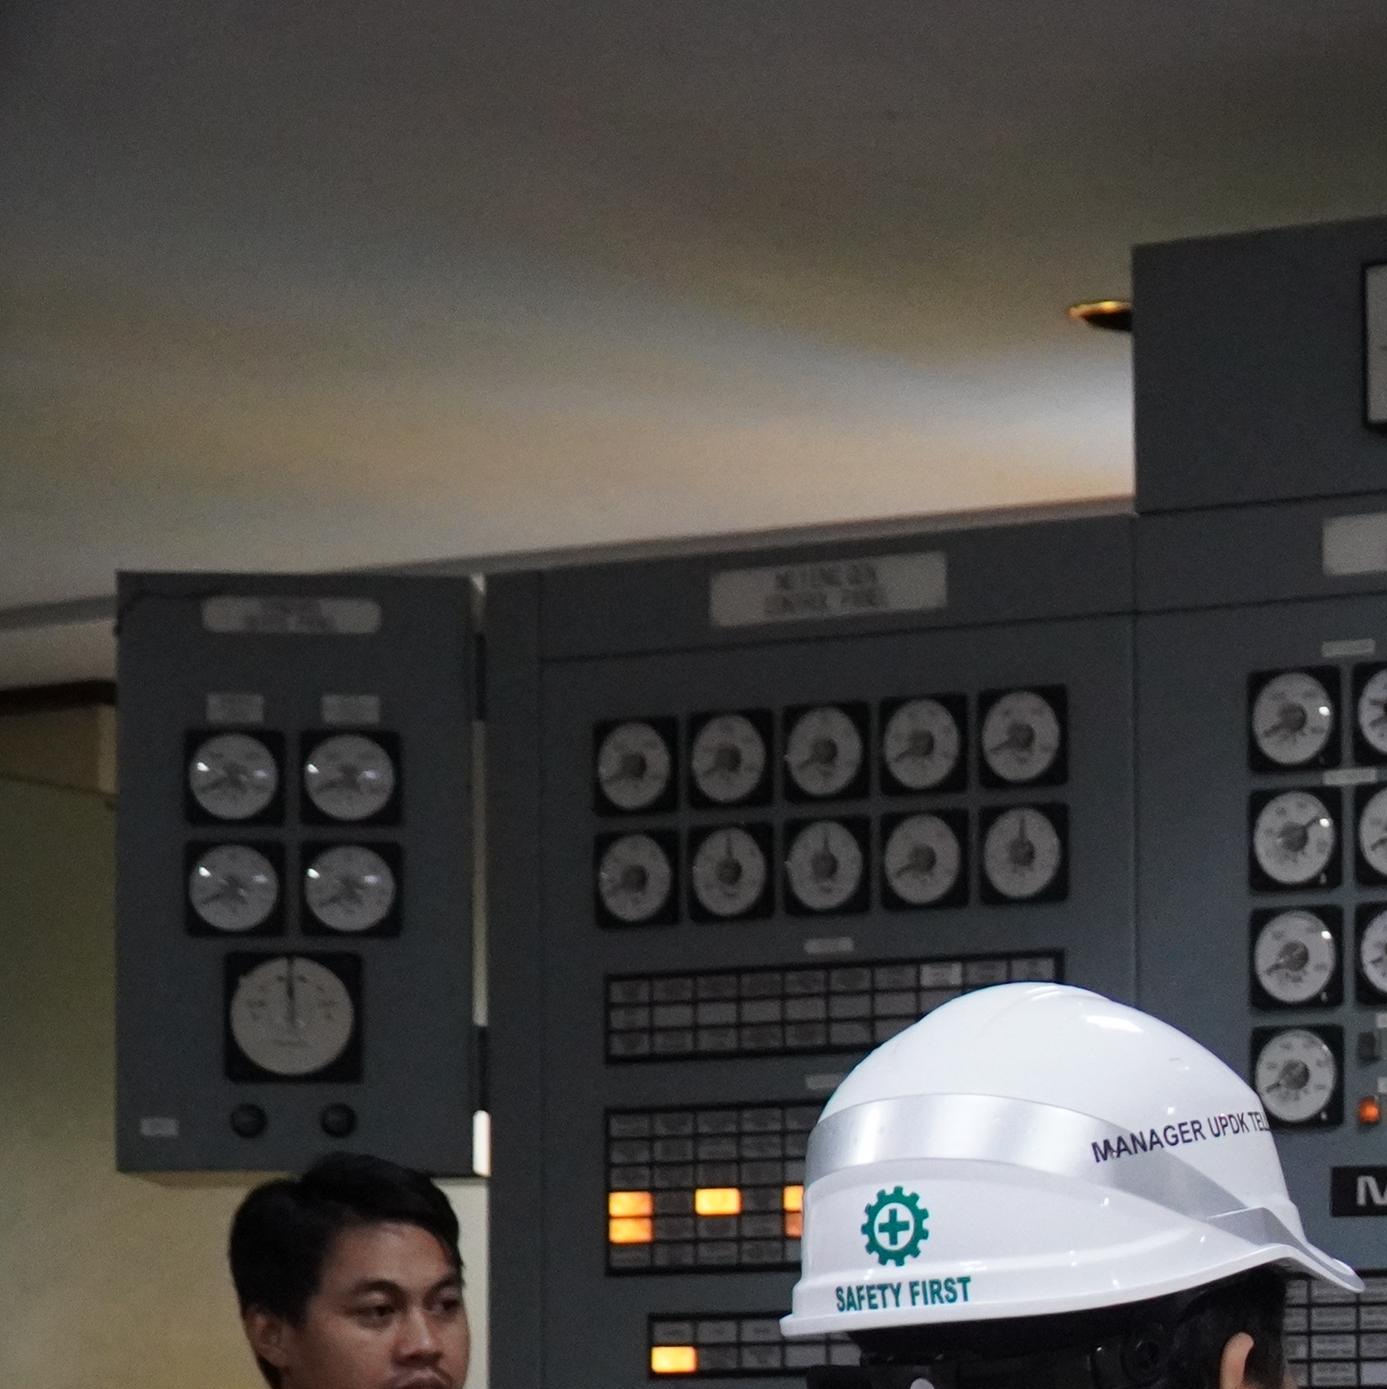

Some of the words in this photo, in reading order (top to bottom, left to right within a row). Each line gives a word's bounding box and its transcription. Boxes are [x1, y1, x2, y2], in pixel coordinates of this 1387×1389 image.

[1092, 1118, 1206, 1164] MANAGER
[1207, 1112, 1249, 1138] UPDK
[835, 1281, 902, 1313] SAFETY
[909, 1276, 971, 1307] FIRST
